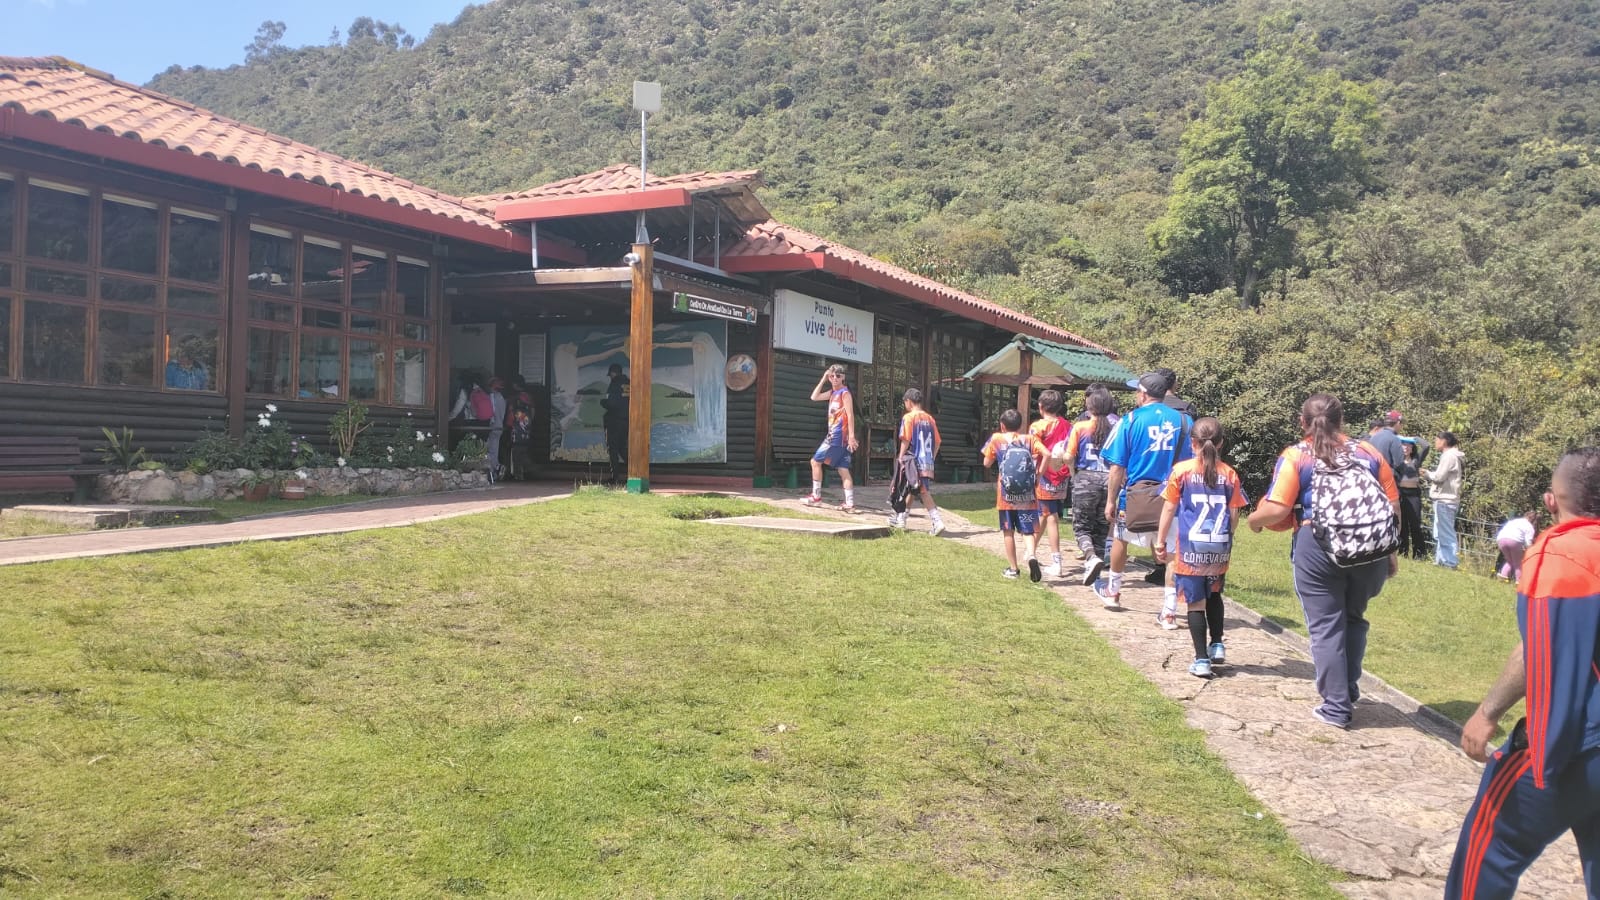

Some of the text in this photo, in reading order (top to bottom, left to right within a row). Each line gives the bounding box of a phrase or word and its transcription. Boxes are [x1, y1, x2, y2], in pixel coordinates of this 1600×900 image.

[805, 316, 857, 345] vive digital
[919, 430, 933, 458] 14
